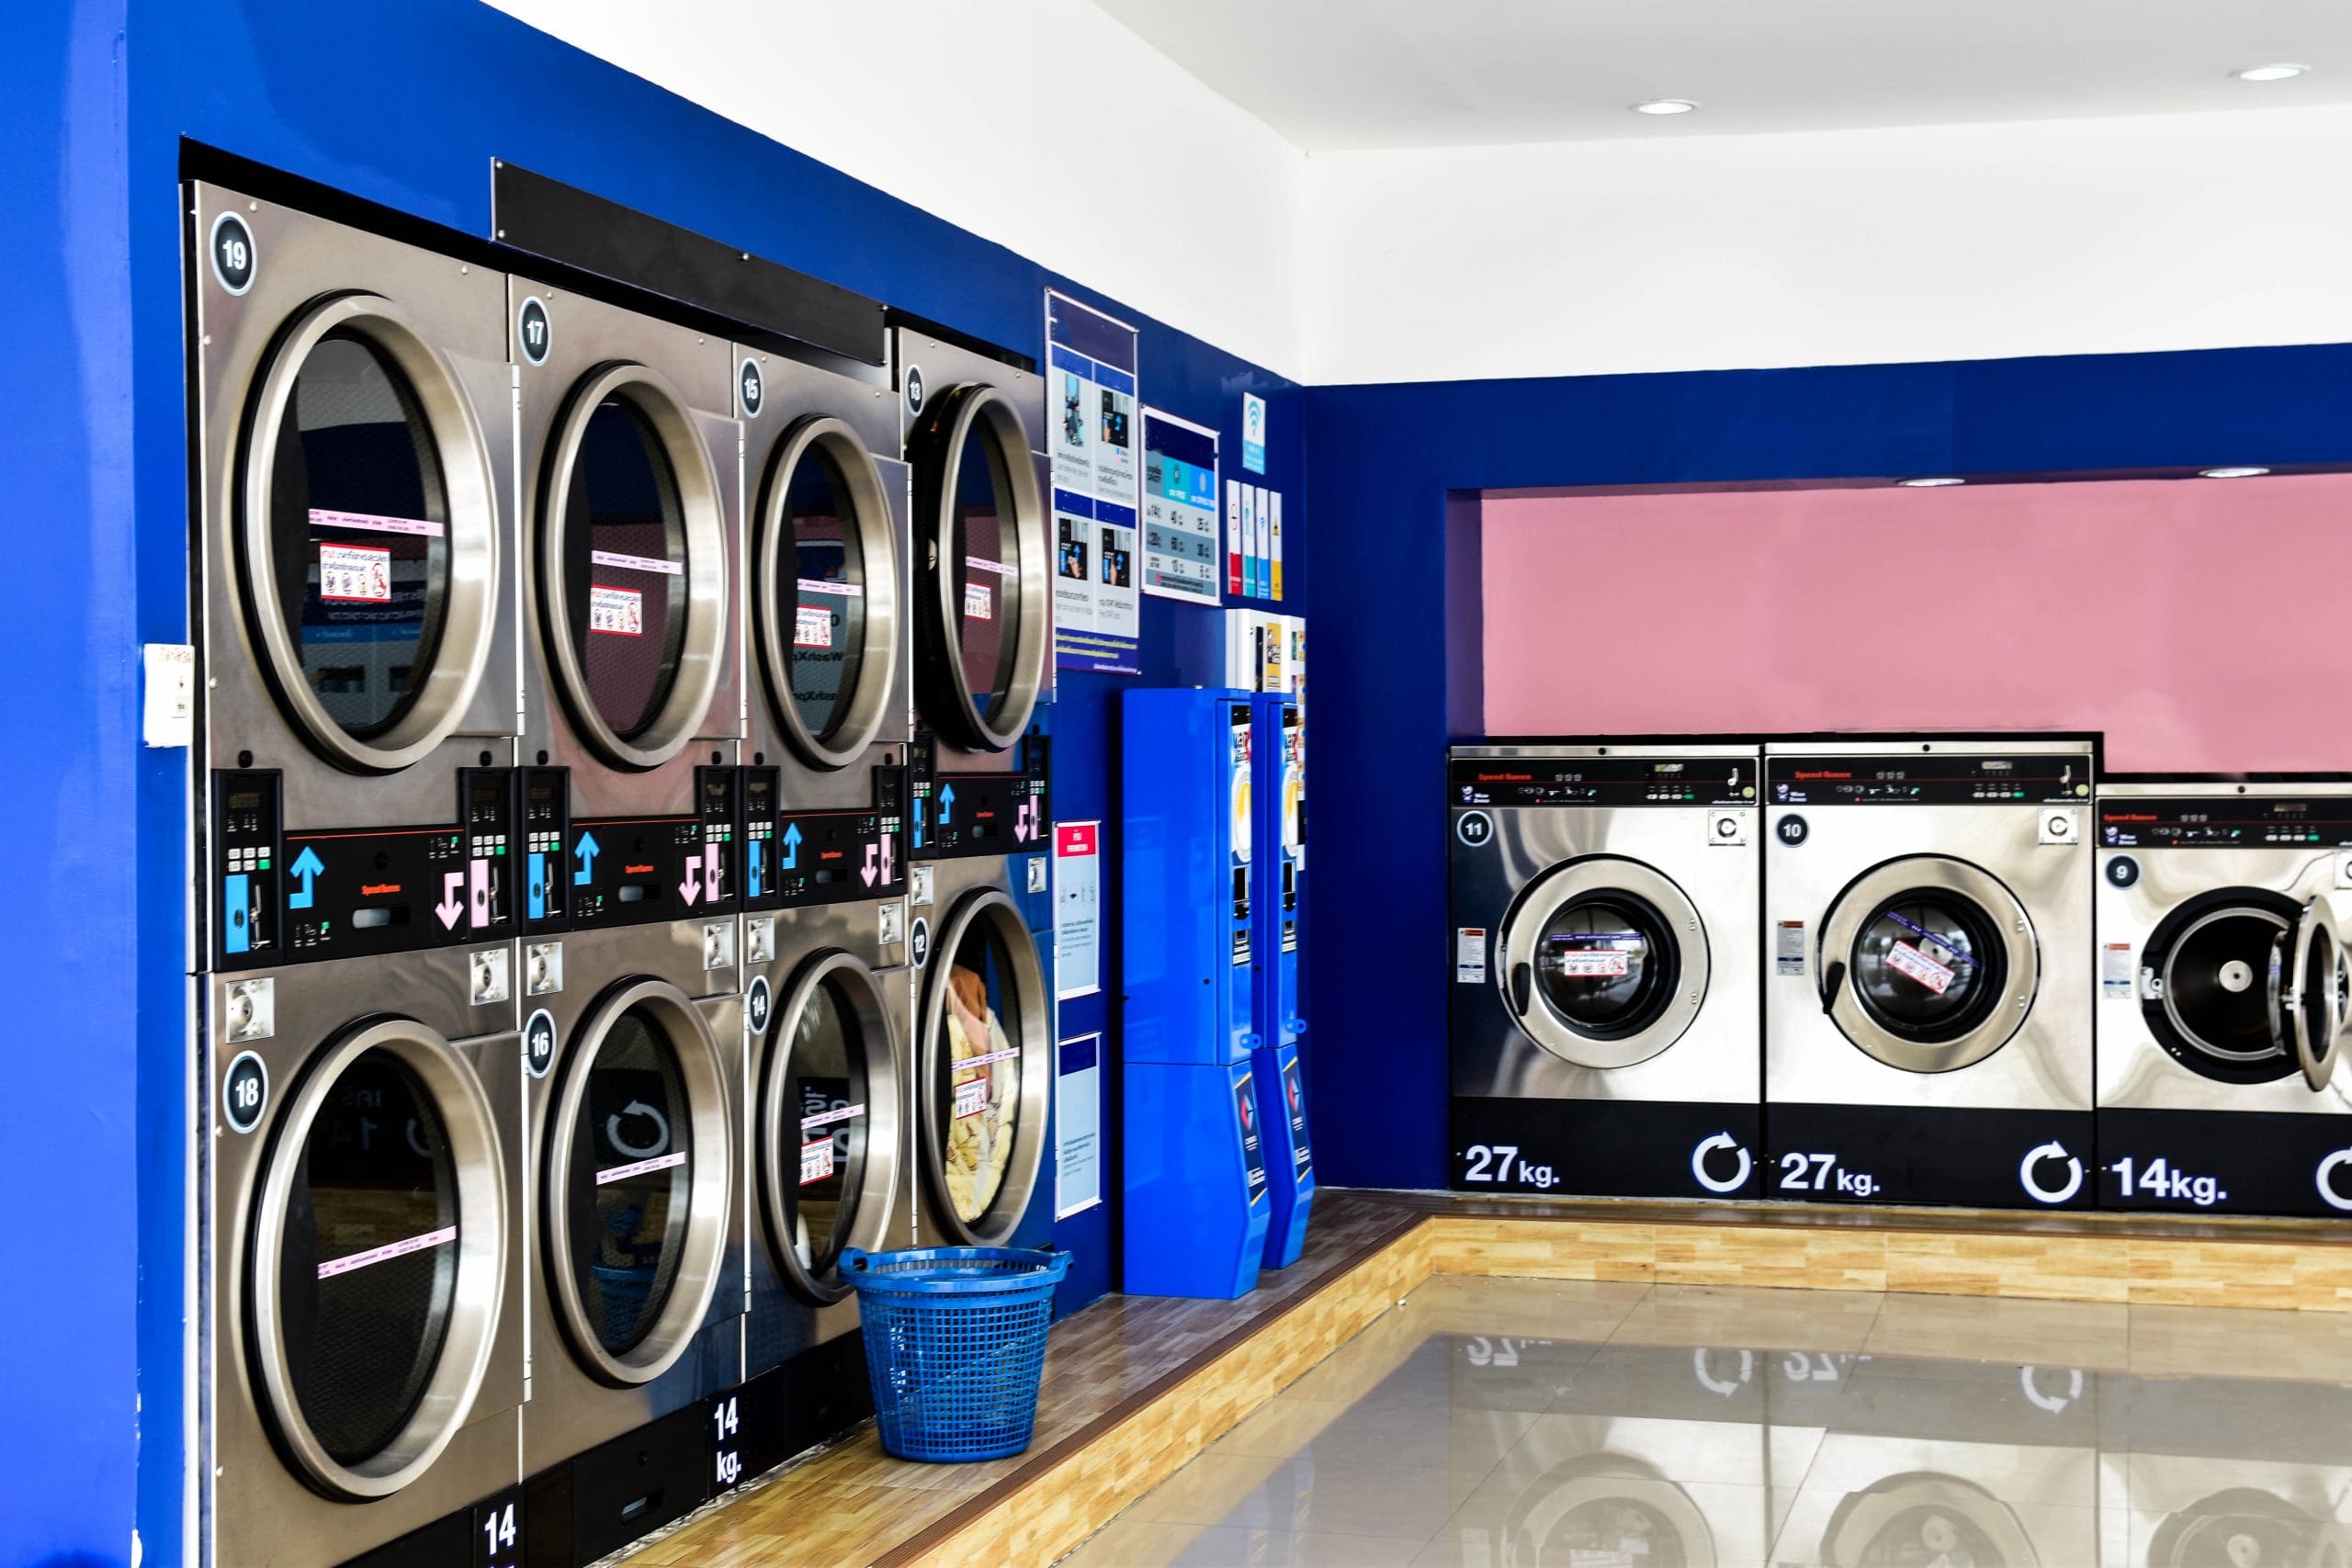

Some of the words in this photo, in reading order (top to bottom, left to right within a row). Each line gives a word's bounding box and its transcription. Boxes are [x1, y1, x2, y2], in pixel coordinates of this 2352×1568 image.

[221, 238, 247, 271] 19
[526, 319, 546, 345] 17
[743, 377, 760, 400] 15
[909, 380, 922, 401] 13
[1464, 821, 1483, 837] 11
[1782, 823, 1803, 838] 10
[2115, 864, 2129, 880] 9
[912, 933, 926, 954] 12
[752, 995, 767, 1018] 14
[530, 1031, 550, 1058] 16
[234, 1077, 259, 1109] 18
[714, 1396, 740, 1441] 14
[716, 1450, 742, 1483] kg.
[484, 1503, 516, 1555] 14
